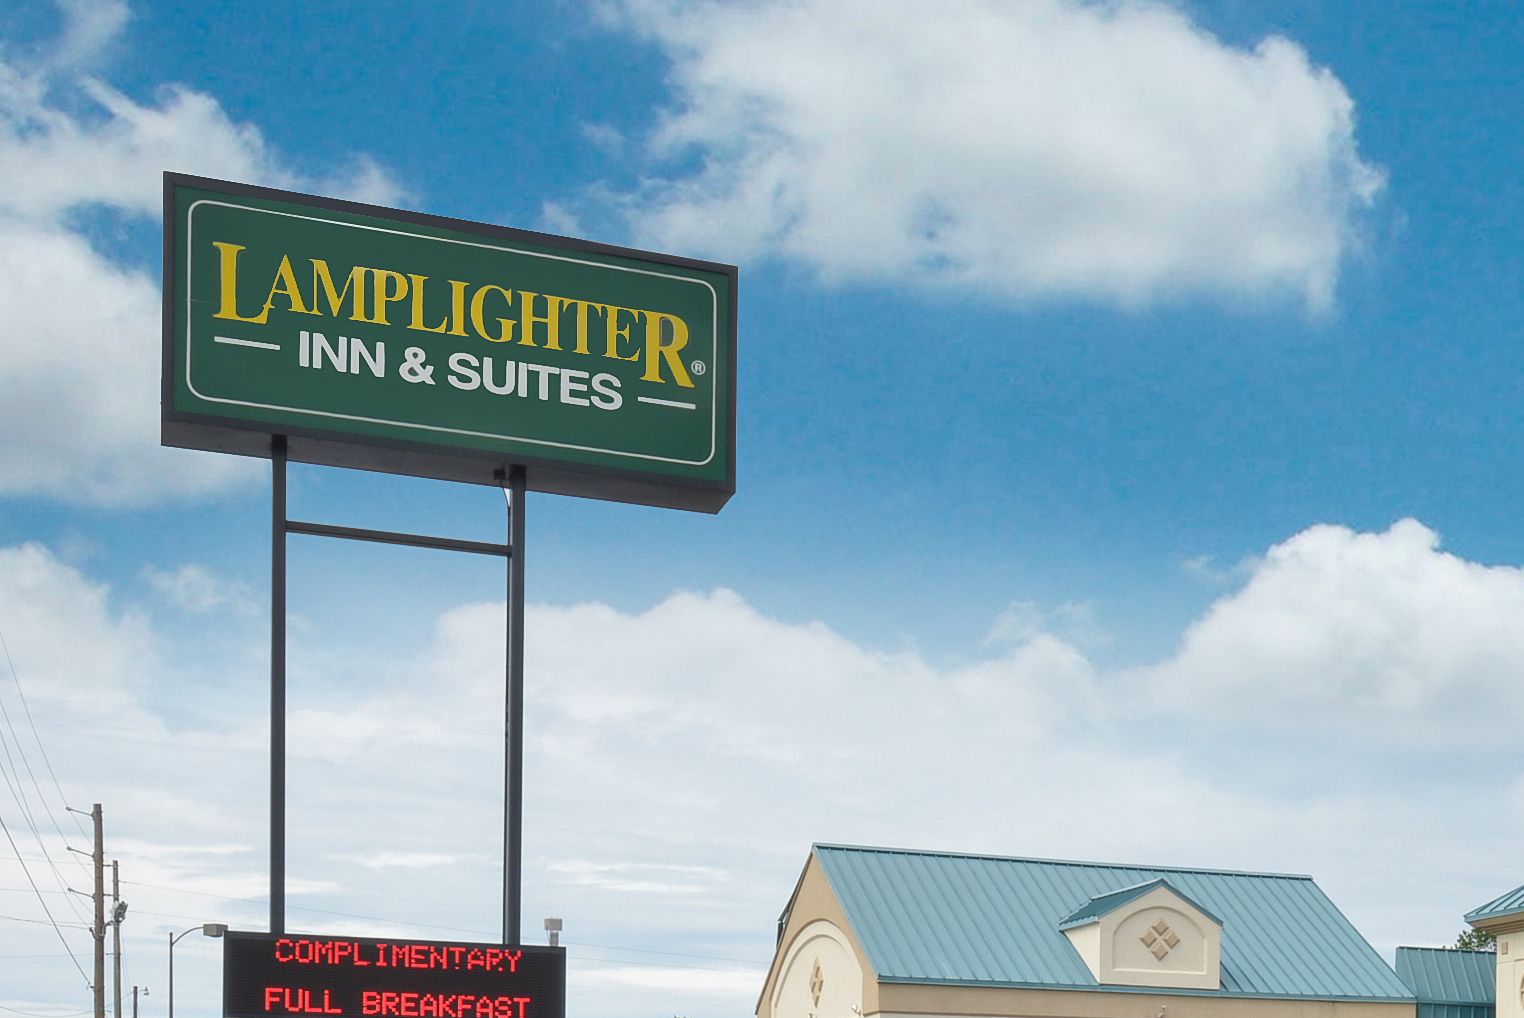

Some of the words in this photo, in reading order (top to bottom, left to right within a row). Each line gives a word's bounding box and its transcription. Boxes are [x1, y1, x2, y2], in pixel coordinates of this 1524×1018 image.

[211, 240, 696, 389] LAMPLIGHTER
[299, 329, 386, 379] INN
[399, 346, 436, 386] &
[447, 352, 624, 412] SUITES
[274, 938, 523, 974] COMPLIMENTARY
[264, 987, 343, 1015] FULL
